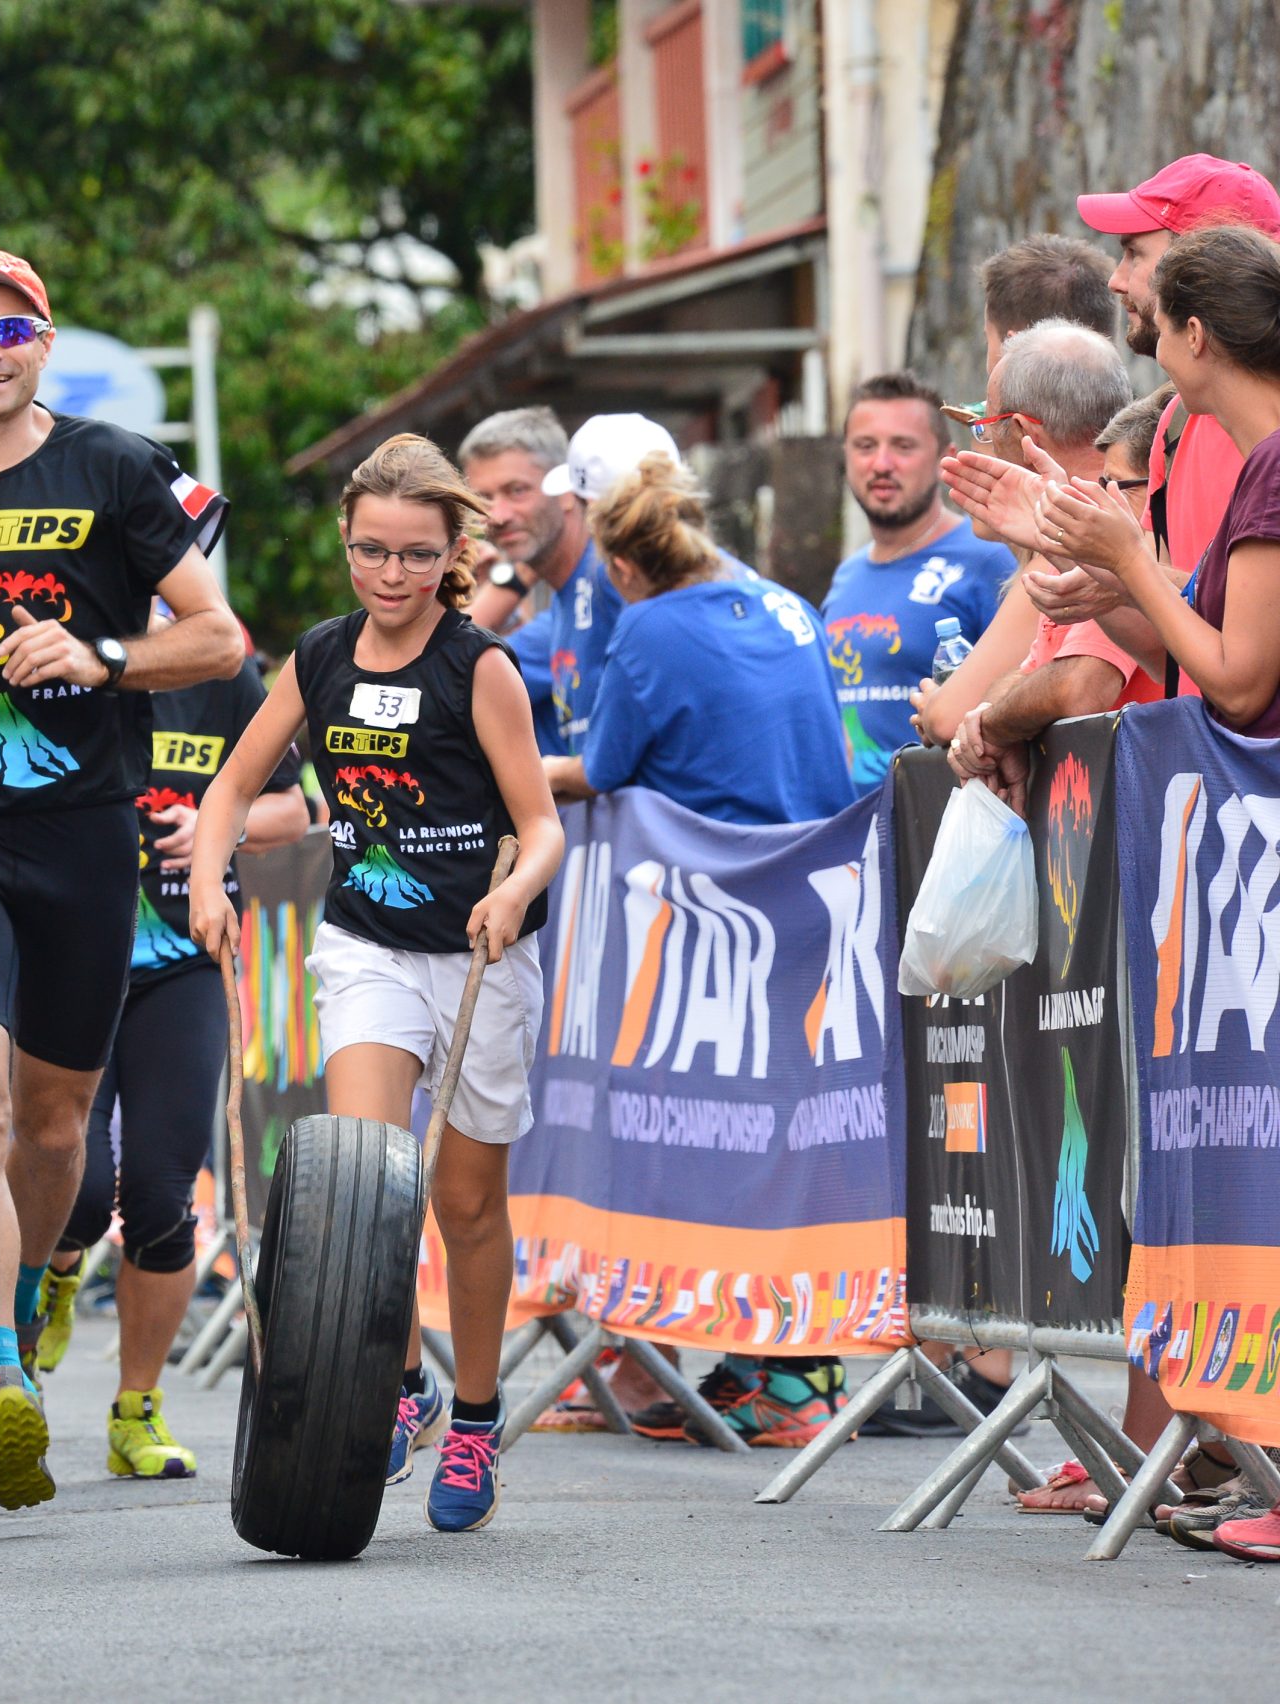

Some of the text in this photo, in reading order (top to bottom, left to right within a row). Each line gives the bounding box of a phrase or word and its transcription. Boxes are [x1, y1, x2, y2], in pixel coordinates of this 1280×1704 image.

[374, 694, 404, 718] 53
[399, 823, 483, 840] LA REUNION
[400, 839, 485, 854] FRANCE 2018
[663, 1095, 776, 1154] CHAMPIONSHIP
